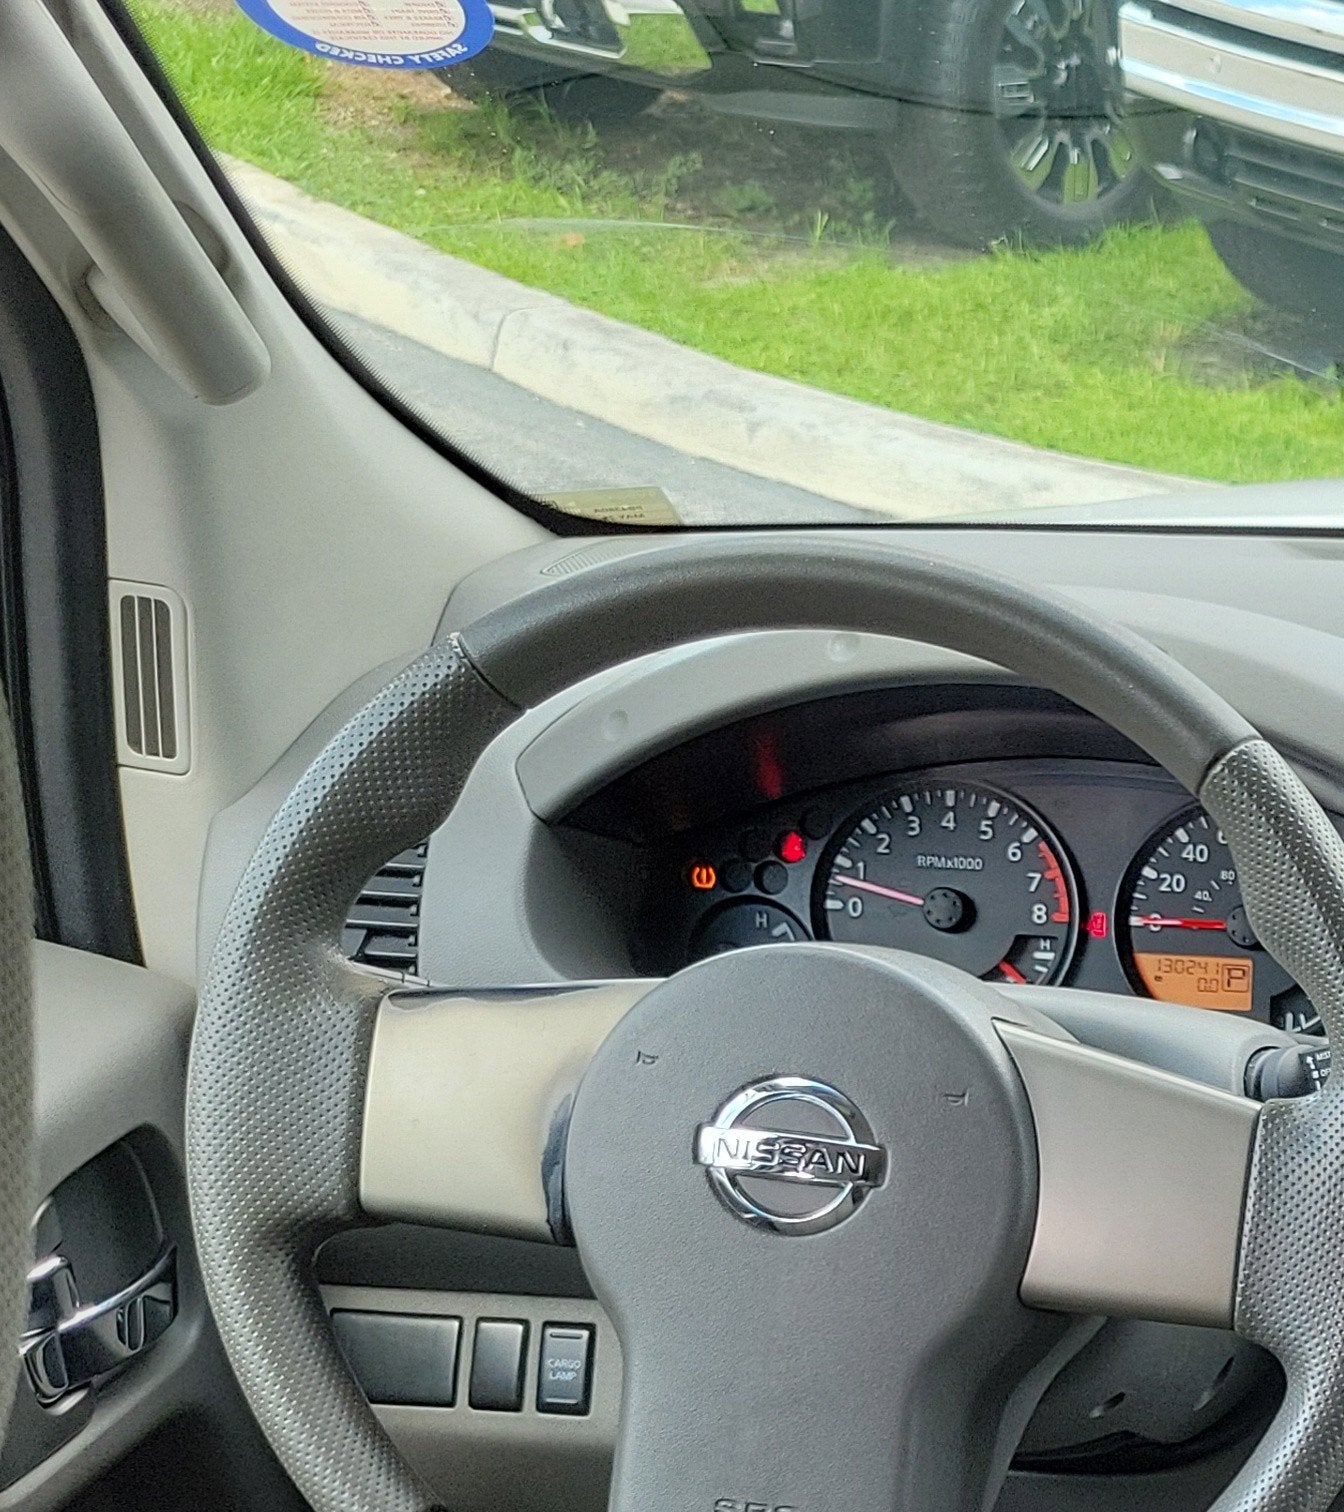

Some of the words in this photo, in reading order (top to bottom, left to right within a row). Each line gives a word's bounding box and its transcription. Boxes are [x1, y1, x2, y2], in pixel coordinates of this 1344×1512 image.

[907, 816, 921, 836] 3
[941, 812, 956, 831] 4
[979, 820, 994, 840] 5
[876, 834, 891, 854] 2
[1007, 842, 1023, 861] 6
[1181, 844, 1209, 862] 40
[1026, 873, 1041, 892] 7
[1159, 874, 1186, 893] 20
[848, 897, 863, 917] 0
[1032, 905, 1047, 924] 8
[1157, 958, 1221, 974] 130241
[1227, 967, 1246, 988] P
[716, 1137, 866, 1177] NISSAN
[547, 1358, 581, 1369] CARGO
[549, 1370, 577, 1380] LAMP
